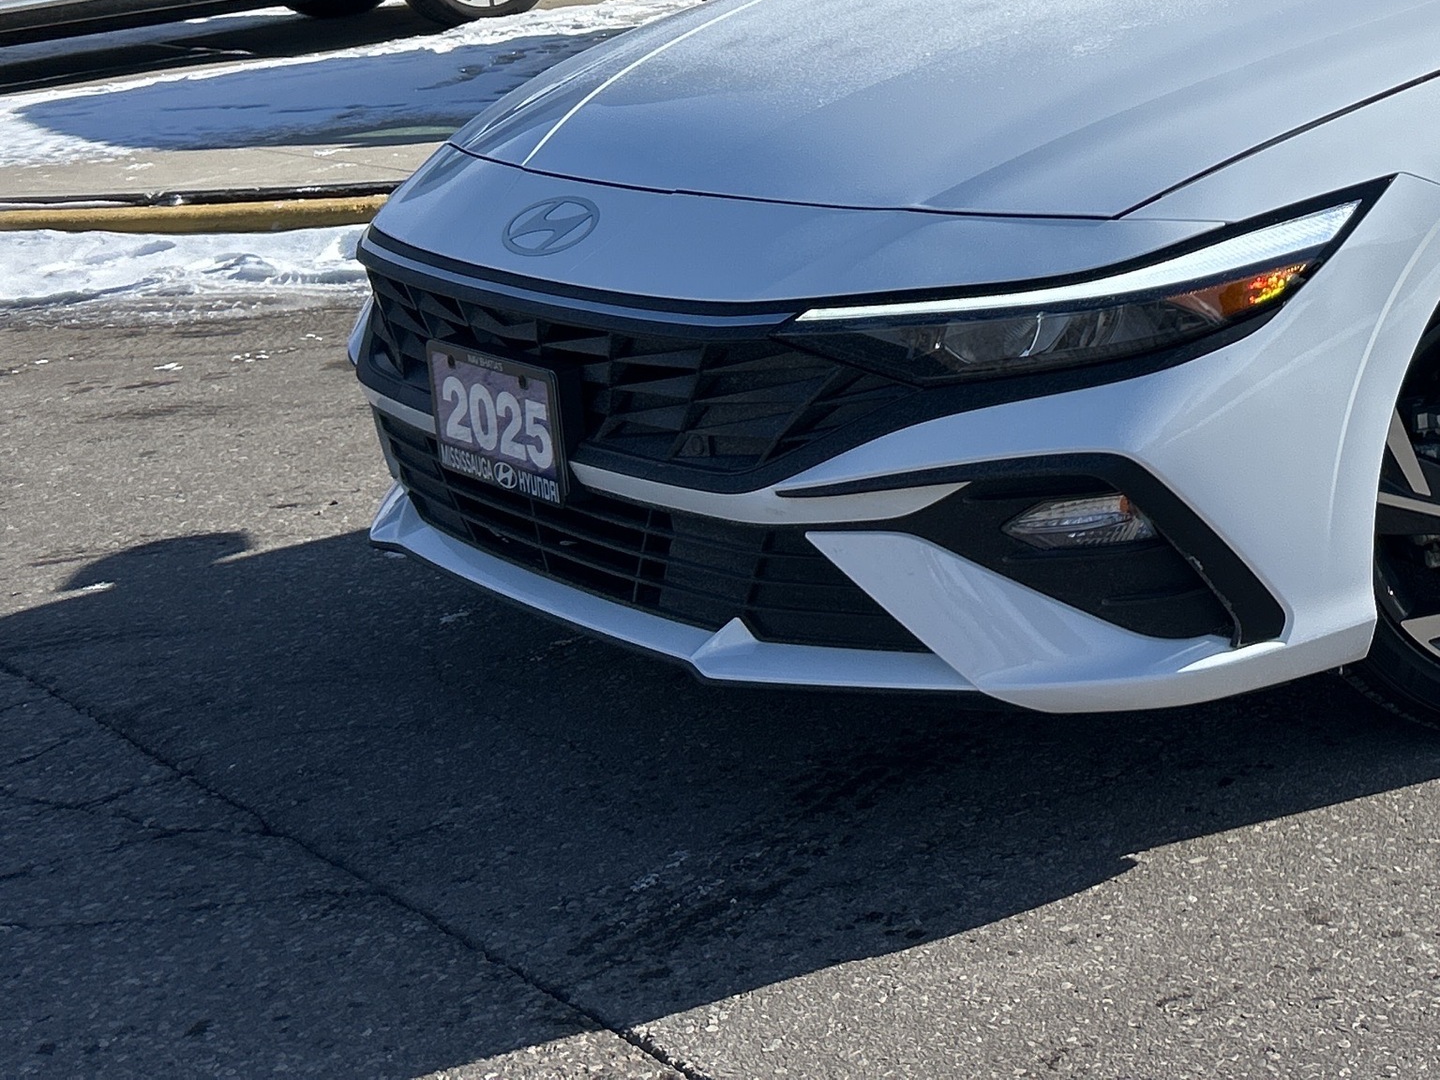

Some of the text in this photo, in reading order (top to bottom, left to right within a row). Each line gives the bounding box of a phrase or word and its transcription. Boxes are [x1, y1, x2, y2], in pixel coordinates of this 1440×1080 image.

[442, 376, 554, 469] 2025
[440, 443, 560, 504] MISSISSAUGA HYUNDAI
